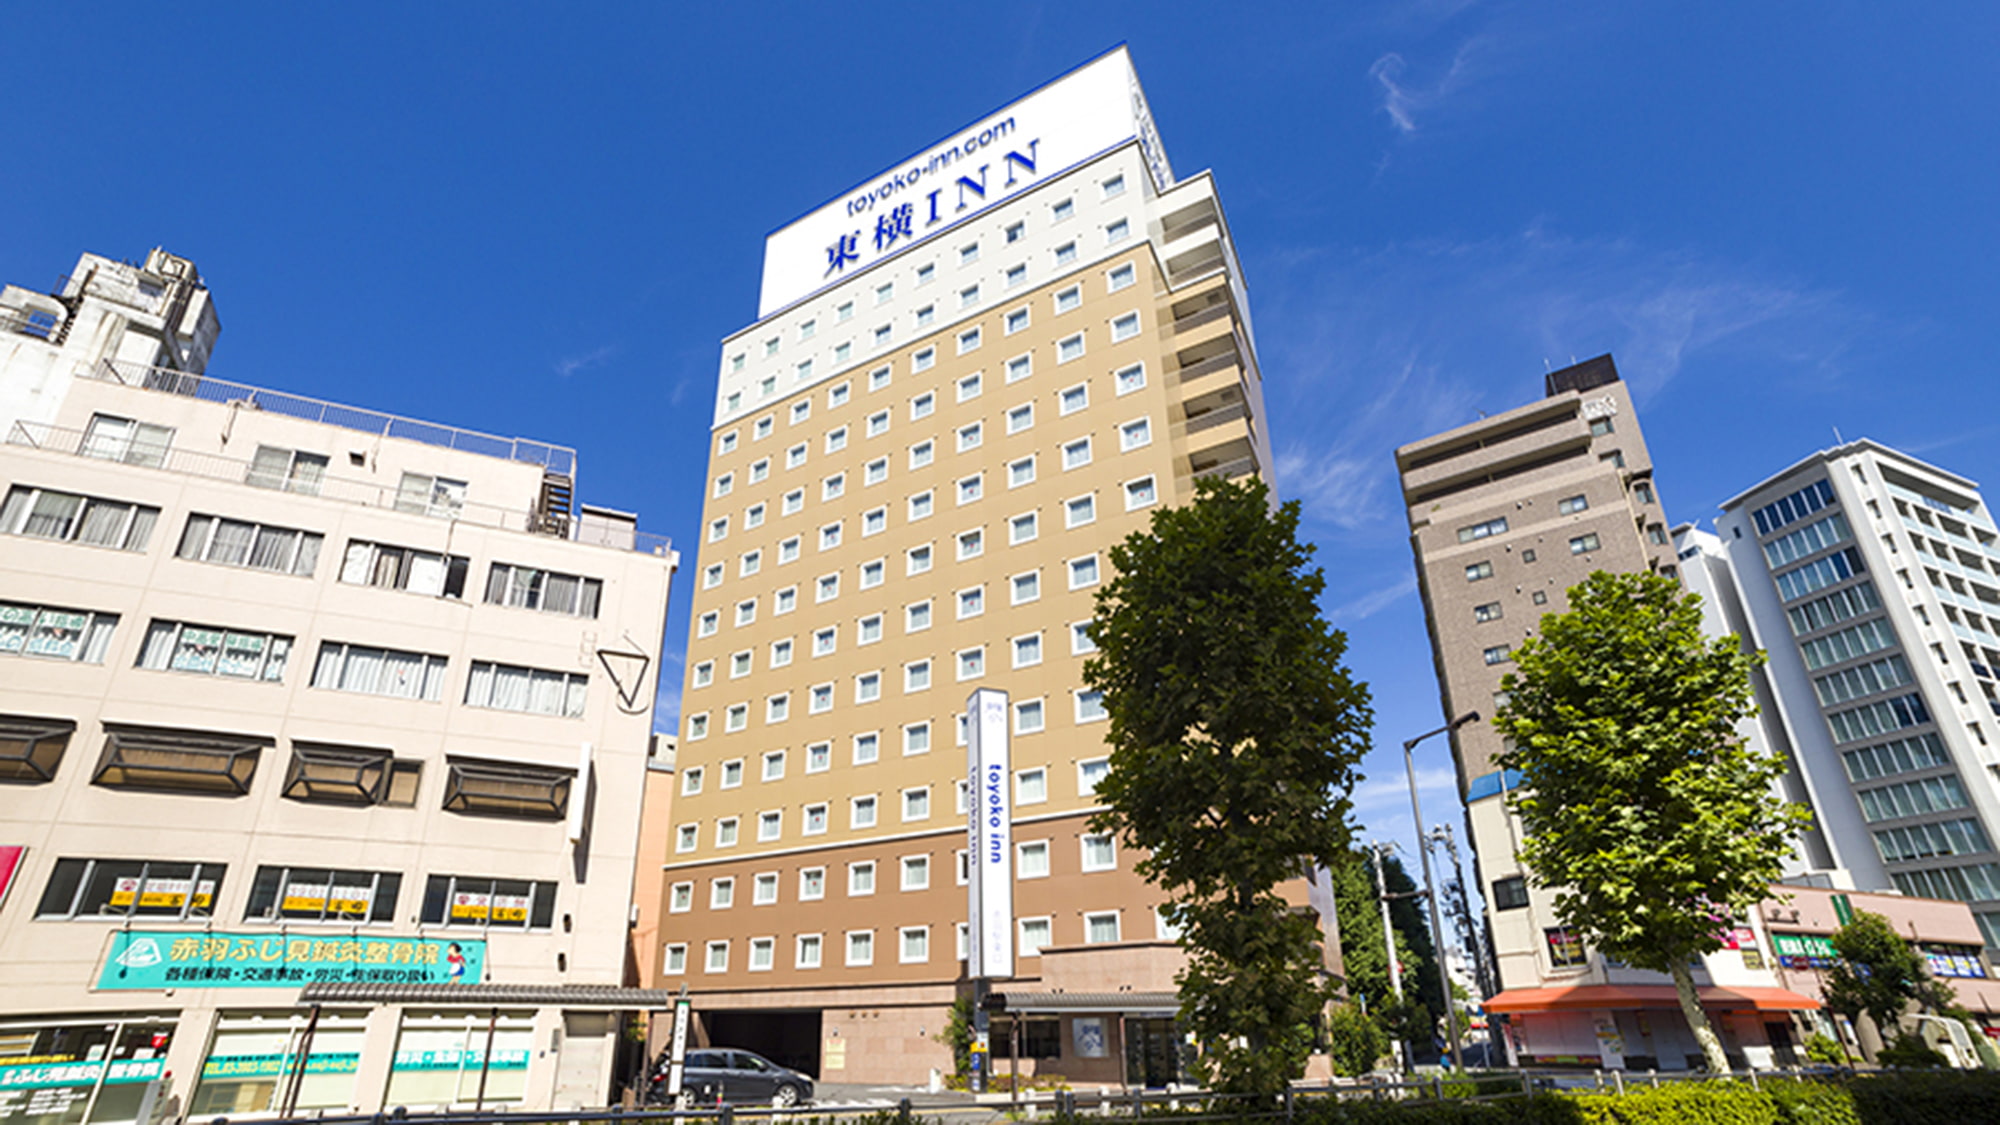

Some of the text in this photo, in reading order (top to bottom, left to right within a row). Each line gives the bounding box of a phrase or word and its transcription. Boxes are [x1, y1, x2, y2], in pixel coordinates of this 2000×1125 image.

[846, 116, 1017, 217] toyoko-inn.com
[986, 763, 1005, 864] toyoko inn
